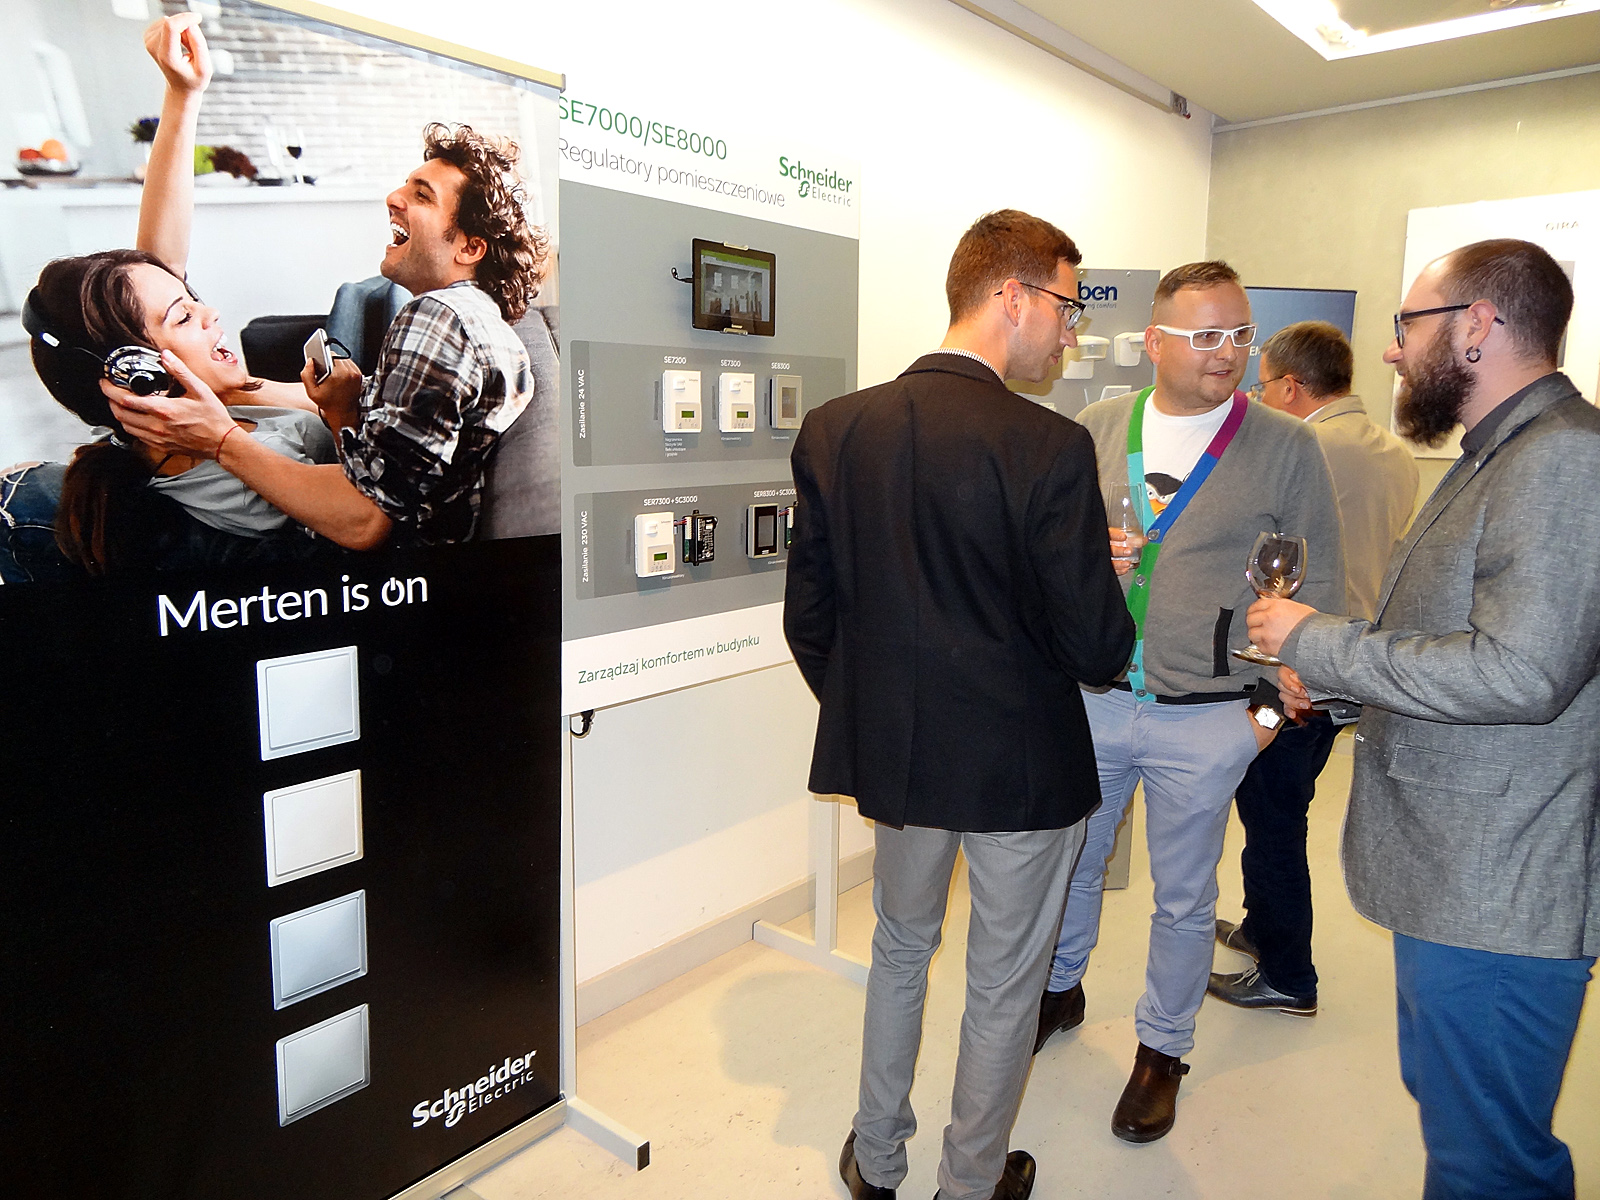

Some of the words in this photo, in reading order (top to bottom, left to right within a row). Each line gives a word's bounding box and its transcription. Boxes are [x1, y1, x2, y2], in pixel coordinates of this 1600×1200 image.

[559, 96, 727, 160] SE7000/SE8000
[559, 137, 652, 182] Regulatory
[658, 164, 785, 207] pomieszczeniowe
[779, 156, 852, 193] Schneider
[811, 186, 851, 207] Electric
[1078, 281, 1118, 301] ben
[663, 355, 687, 365] SE7200
[720, 359, 741, 368] SE7300
[578, 385, 586, 400] 24
[674, 495, 698, 505] SC3000
[581, 531, 589, 548] 230
[582, 548, 590, 583] Zasilanie
[158, 586, 328, 637] Merten
[341, 574, 370, 613] is
[381, 576, 428, 606] on
[578, 658, 639, 684] Zarządzaj
[641, 647, 704, 670] komfortem
[706, 647, 715, 656] w
[716, 635, 760, 654] budynku
[412, 1049, 537, 1128] Schneider
[468, 1070, 534, 1113] Electric
